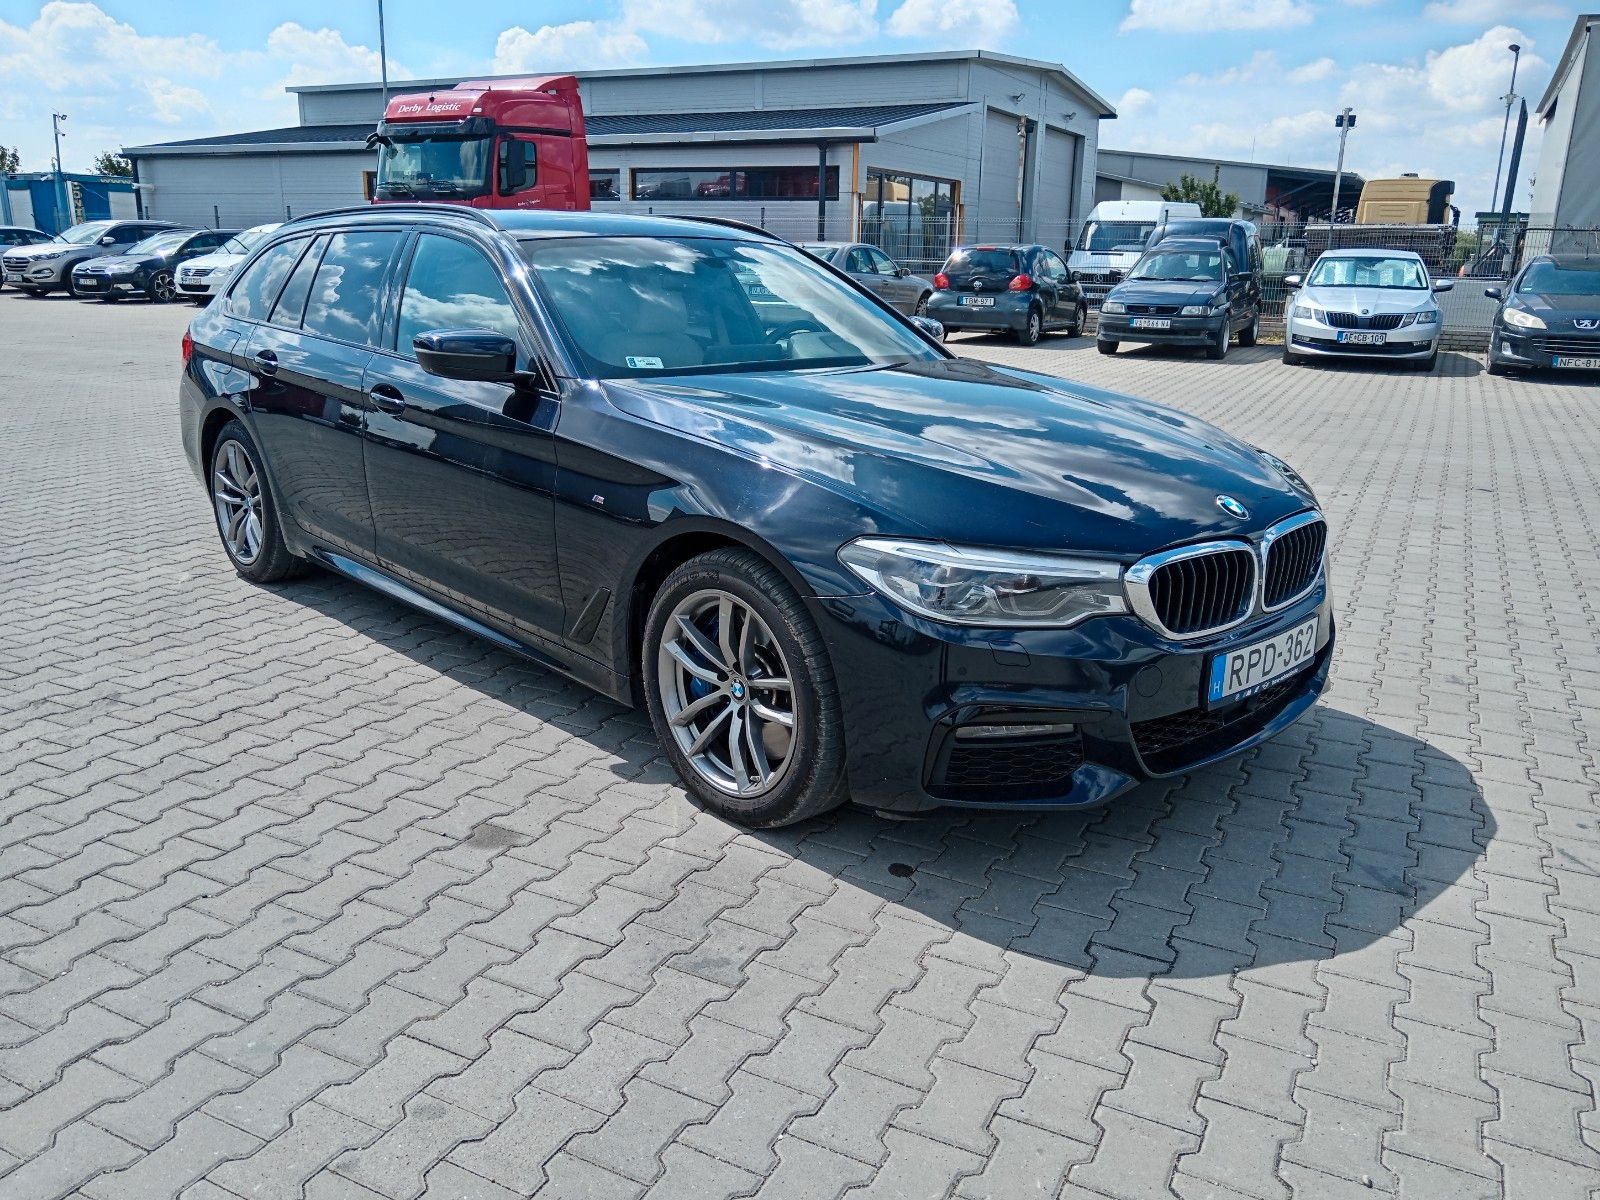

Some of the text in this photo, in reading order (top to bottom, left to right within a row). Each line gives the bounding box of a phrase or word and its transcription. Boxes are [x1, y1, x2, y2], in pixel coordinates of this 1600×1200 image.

[398, 103, 461, 114] Derby Logistic
[1229, 624, 1313, 690] RPD-362
[1213, 681, 1220, 694] H
